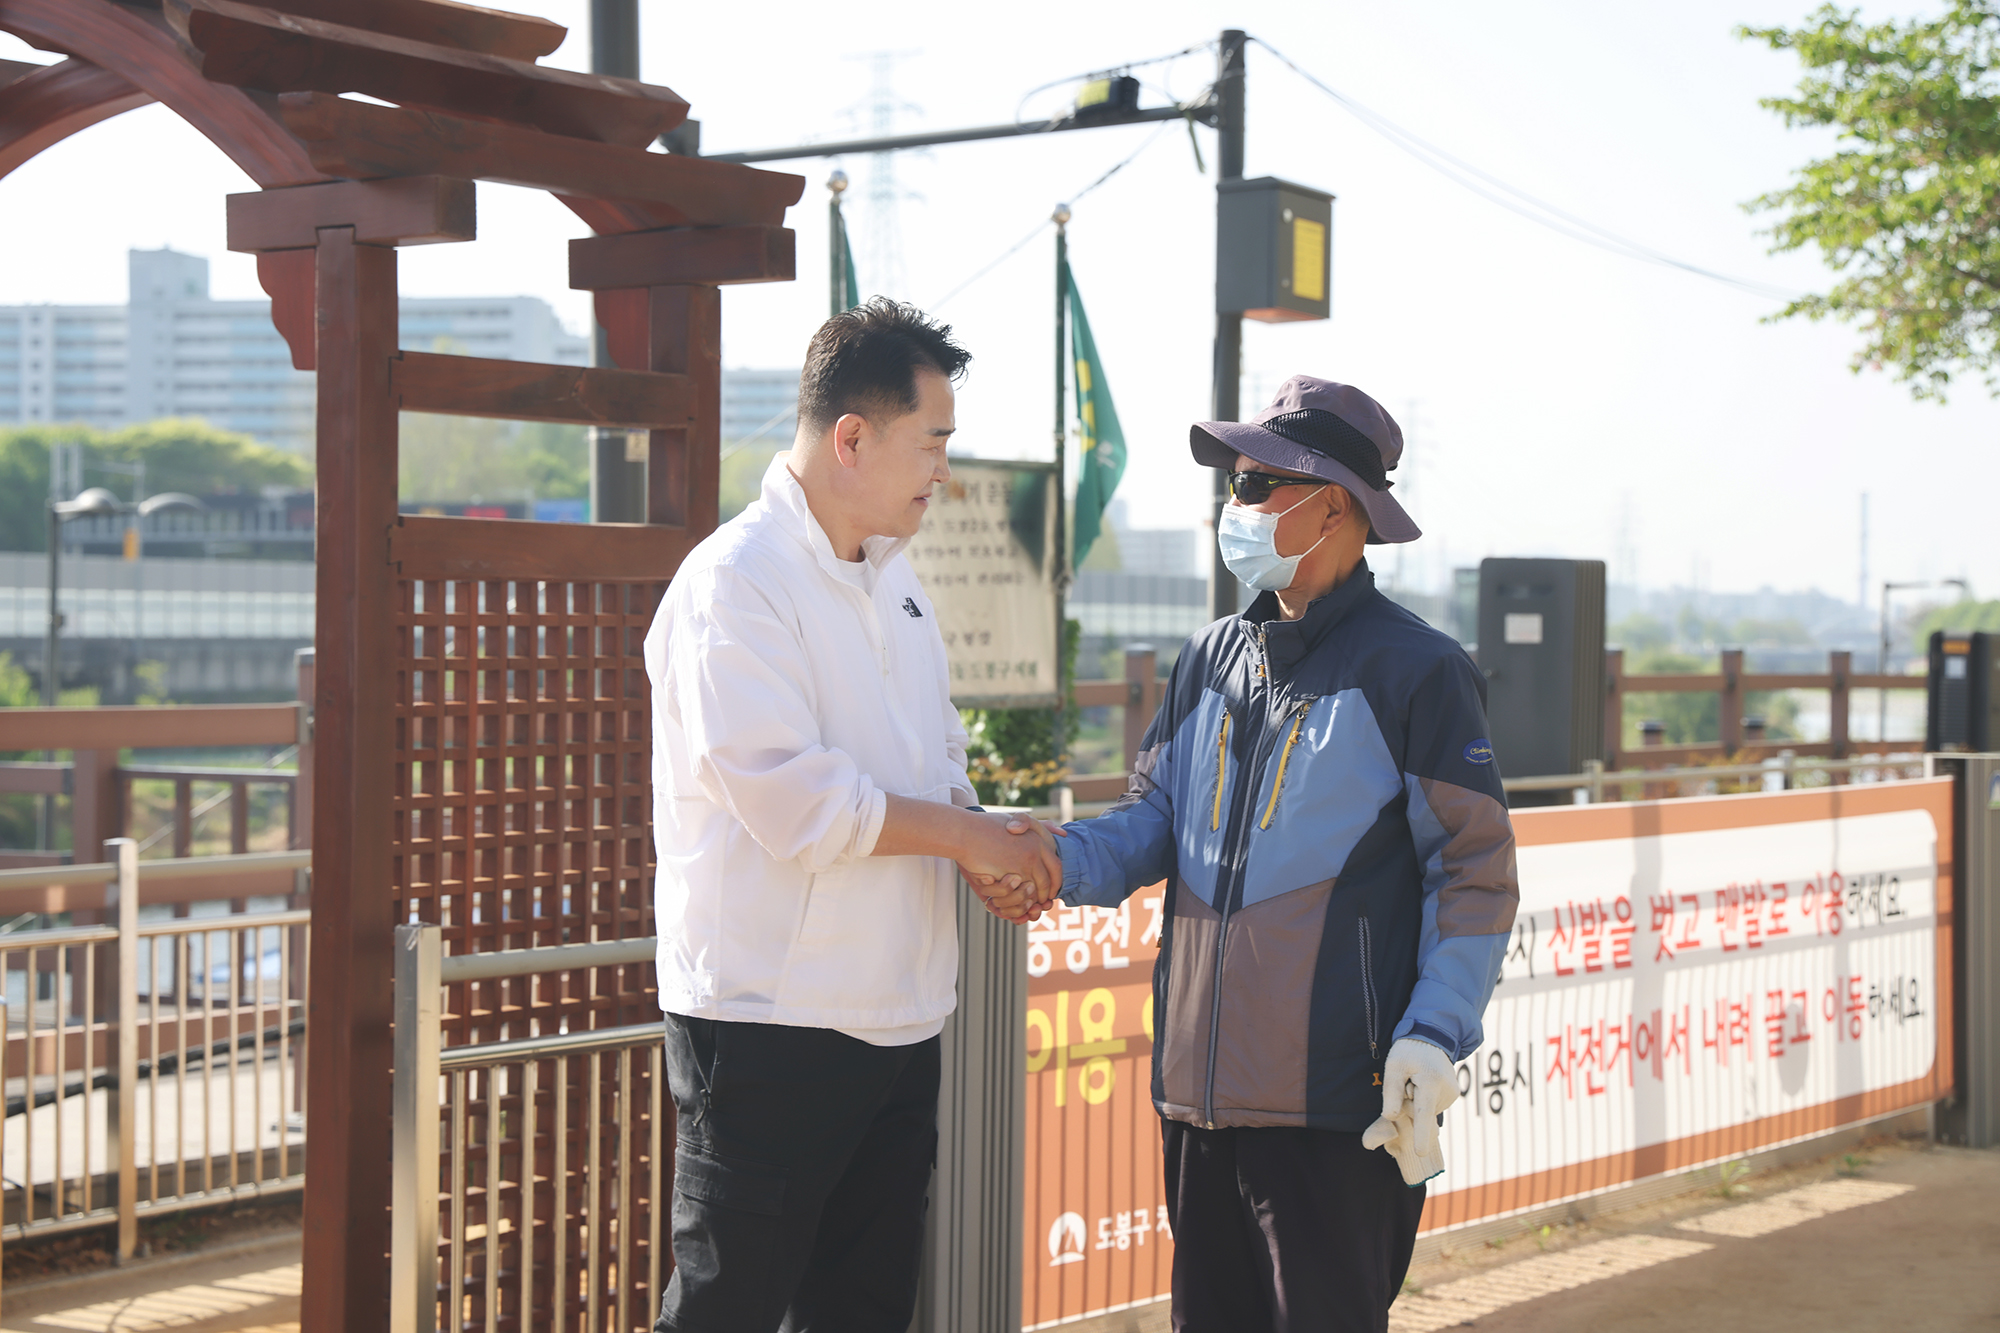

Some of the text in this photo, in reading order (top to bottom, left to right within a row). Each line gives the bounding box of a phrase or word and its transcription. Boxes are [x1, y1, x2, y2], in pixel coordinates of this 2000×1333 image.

[1547, 894, 1638, 978] 신발을
[1649, 888, 1702, 963] 벗고
[1714, 879, 1790, 953] 맨발로
[1026, 987, 1127, 1107] 이용
[1457, 1042, 1534, 1116] 이용시
[1546, 1004, 1692, 1100] 자전거에서
[1702, 992, 1753, 1068] 내려
[1764, 988, 1814, 1059] 끌고
[1094, 1208, 1152, 1251] 도봉구
